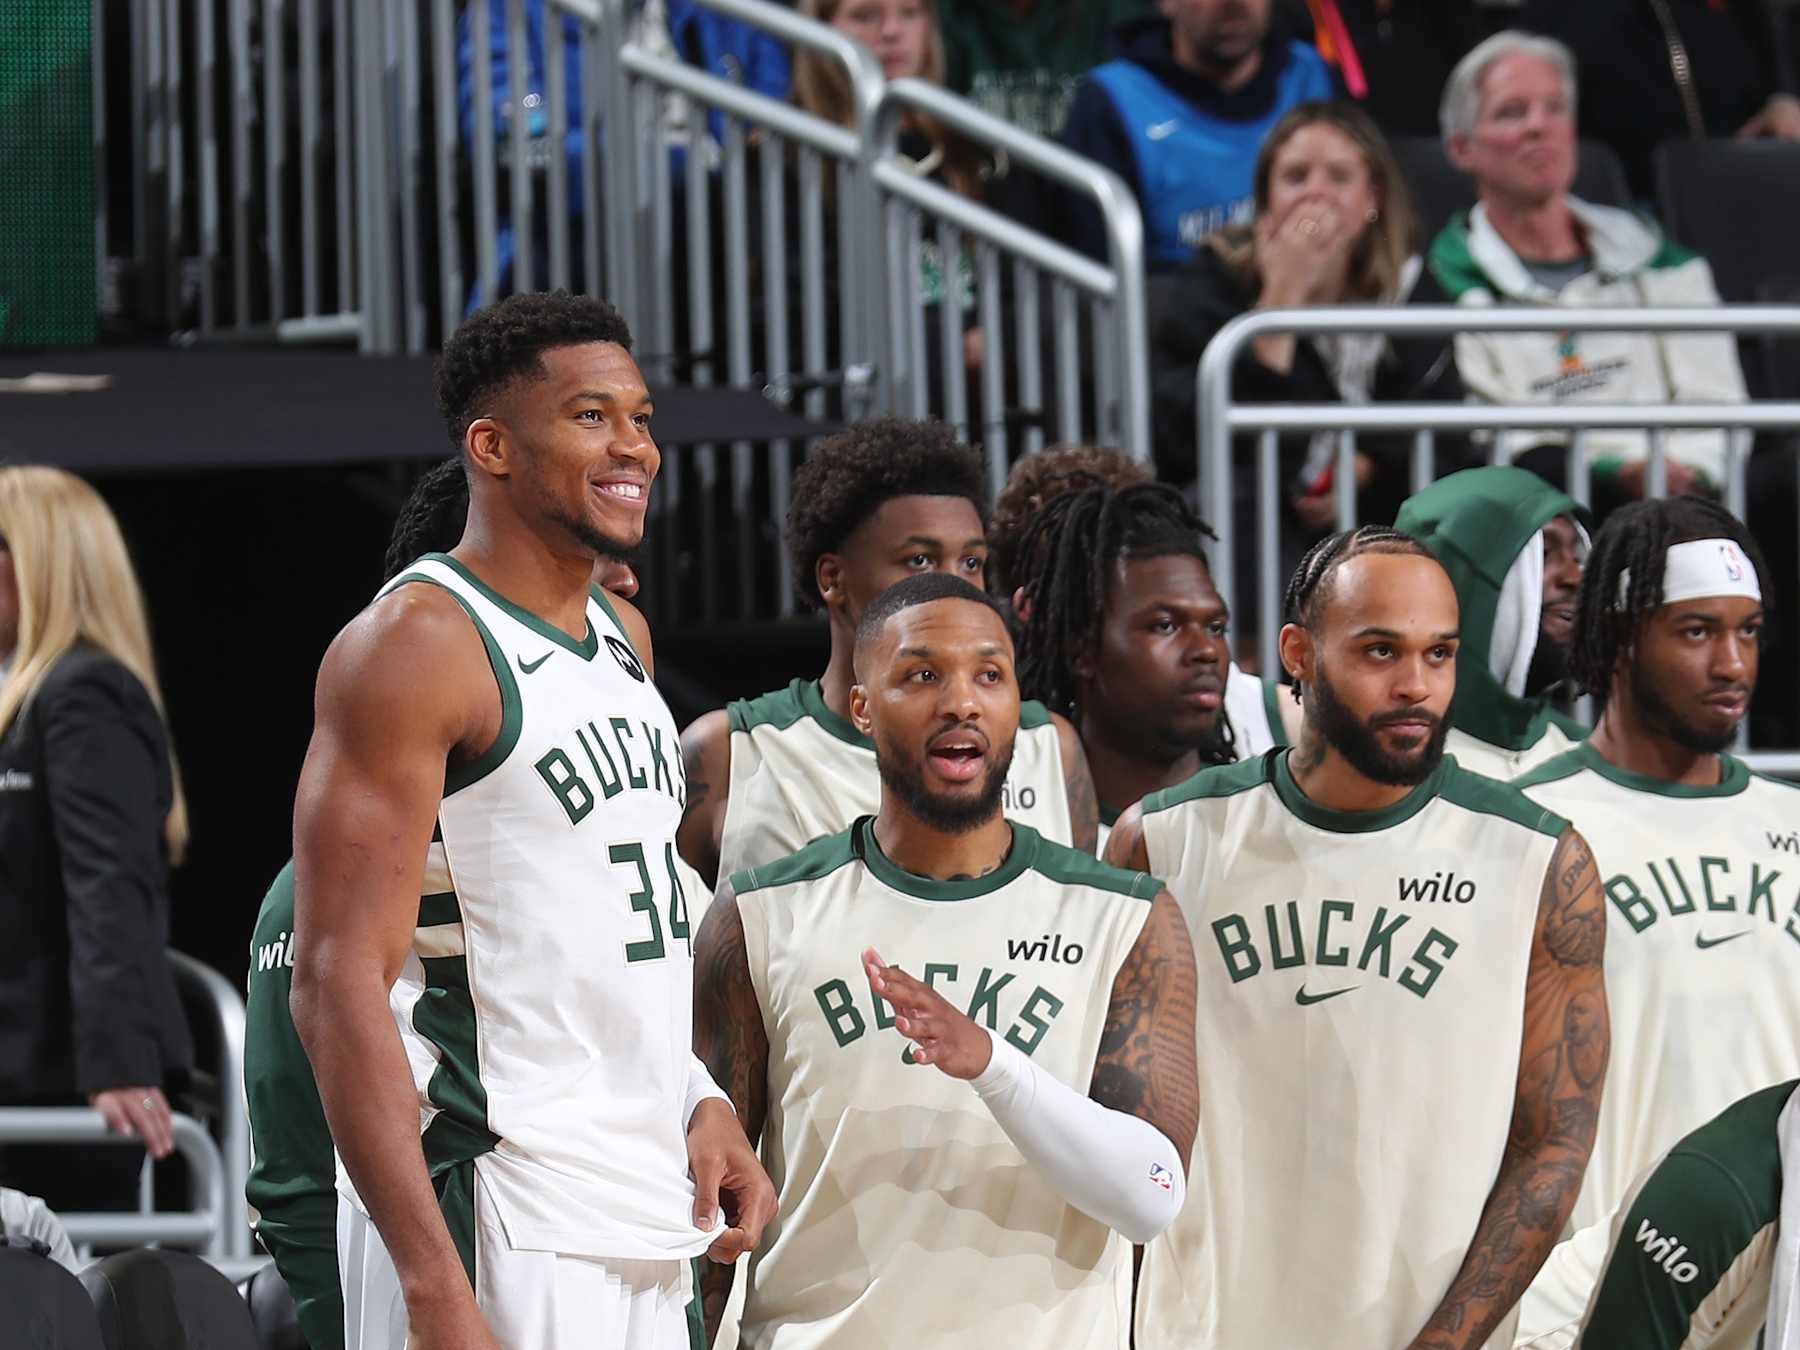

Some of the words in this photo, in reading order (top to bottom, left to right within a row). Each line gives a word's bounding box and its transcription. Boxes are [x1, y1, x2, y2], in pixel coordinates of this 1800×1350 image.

[1000, 779, 1036, 810] ilo
[1766, 831, 1800, 855] wi
[608, 842, 691, 962] 34
[1399, 872, 1476, 904] wilo
[258, 931, 295, 972] wil
[1007, 934, 1083, 965] wilo
[1211, 900, 1459, 999] BUCKS
[1635, 1218, 1699, 1283] wilo
